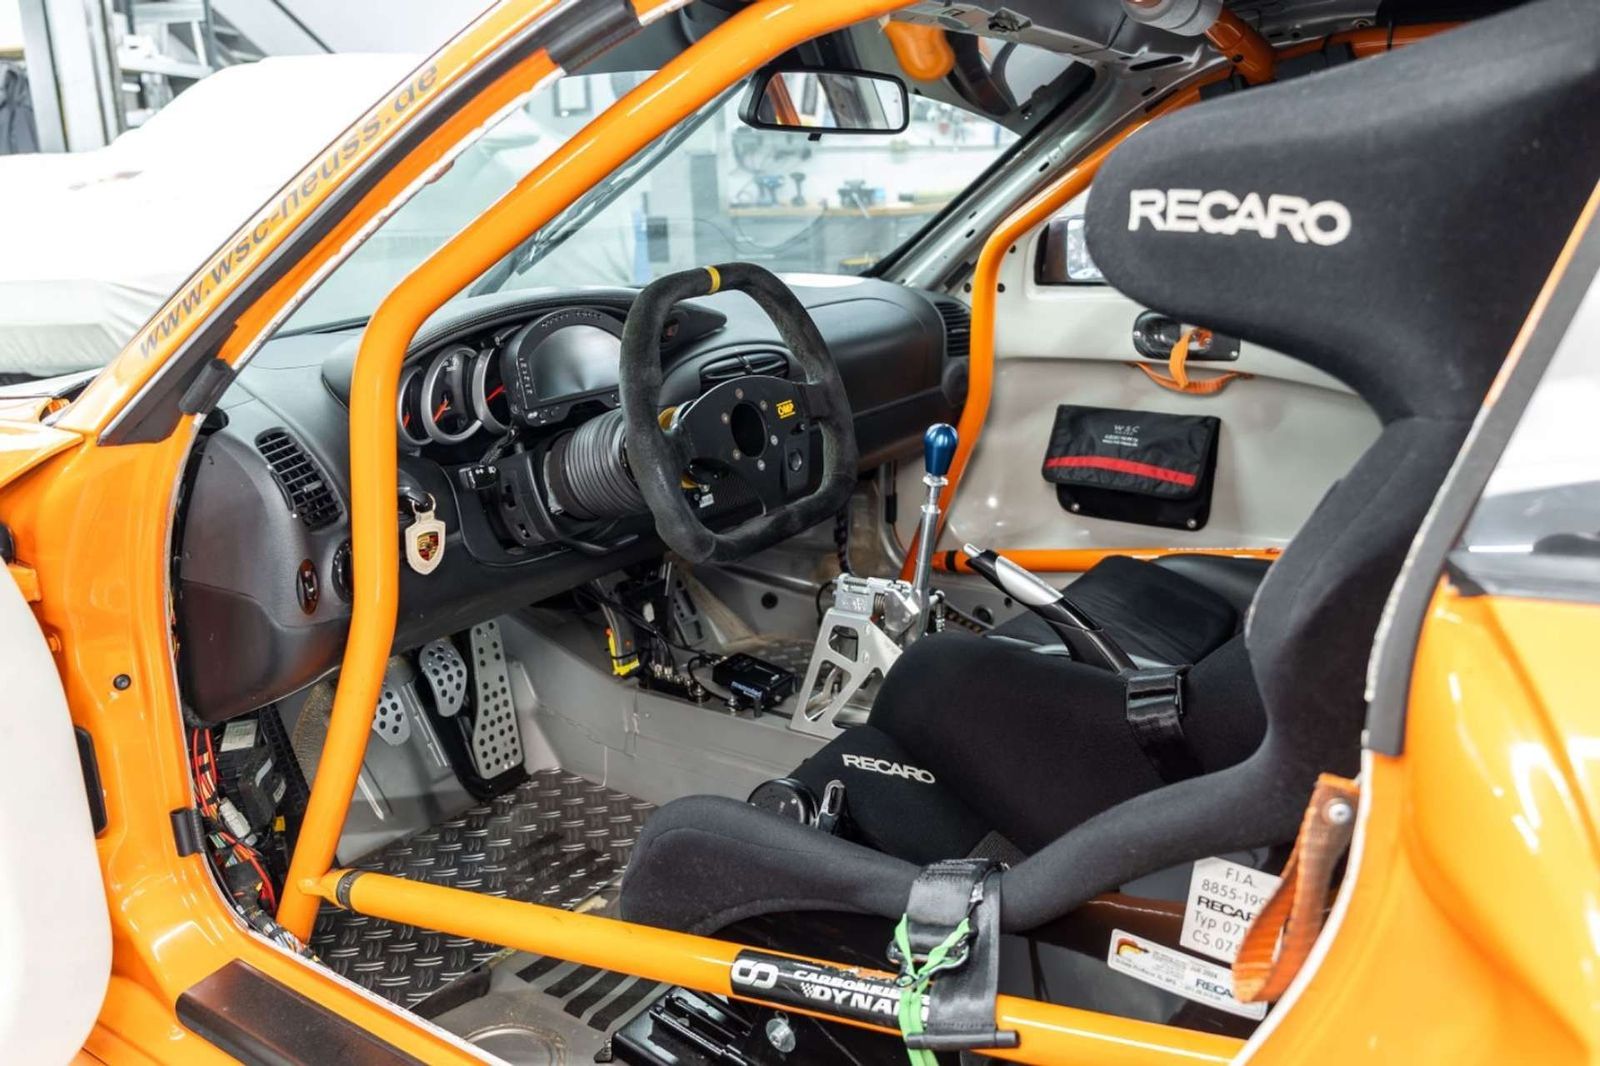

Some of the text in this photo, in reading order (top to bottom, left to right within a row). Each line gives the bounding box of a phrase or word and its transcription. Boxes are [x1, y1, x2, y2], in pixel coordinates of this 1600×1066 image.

[139, 63, 438, 359] www.wsc-neuss.de
[1128, 189, 1352, 246] RECARO
[842, 754, 936, 784] RECARO
[1195, 911, 1217, 930] Typ
